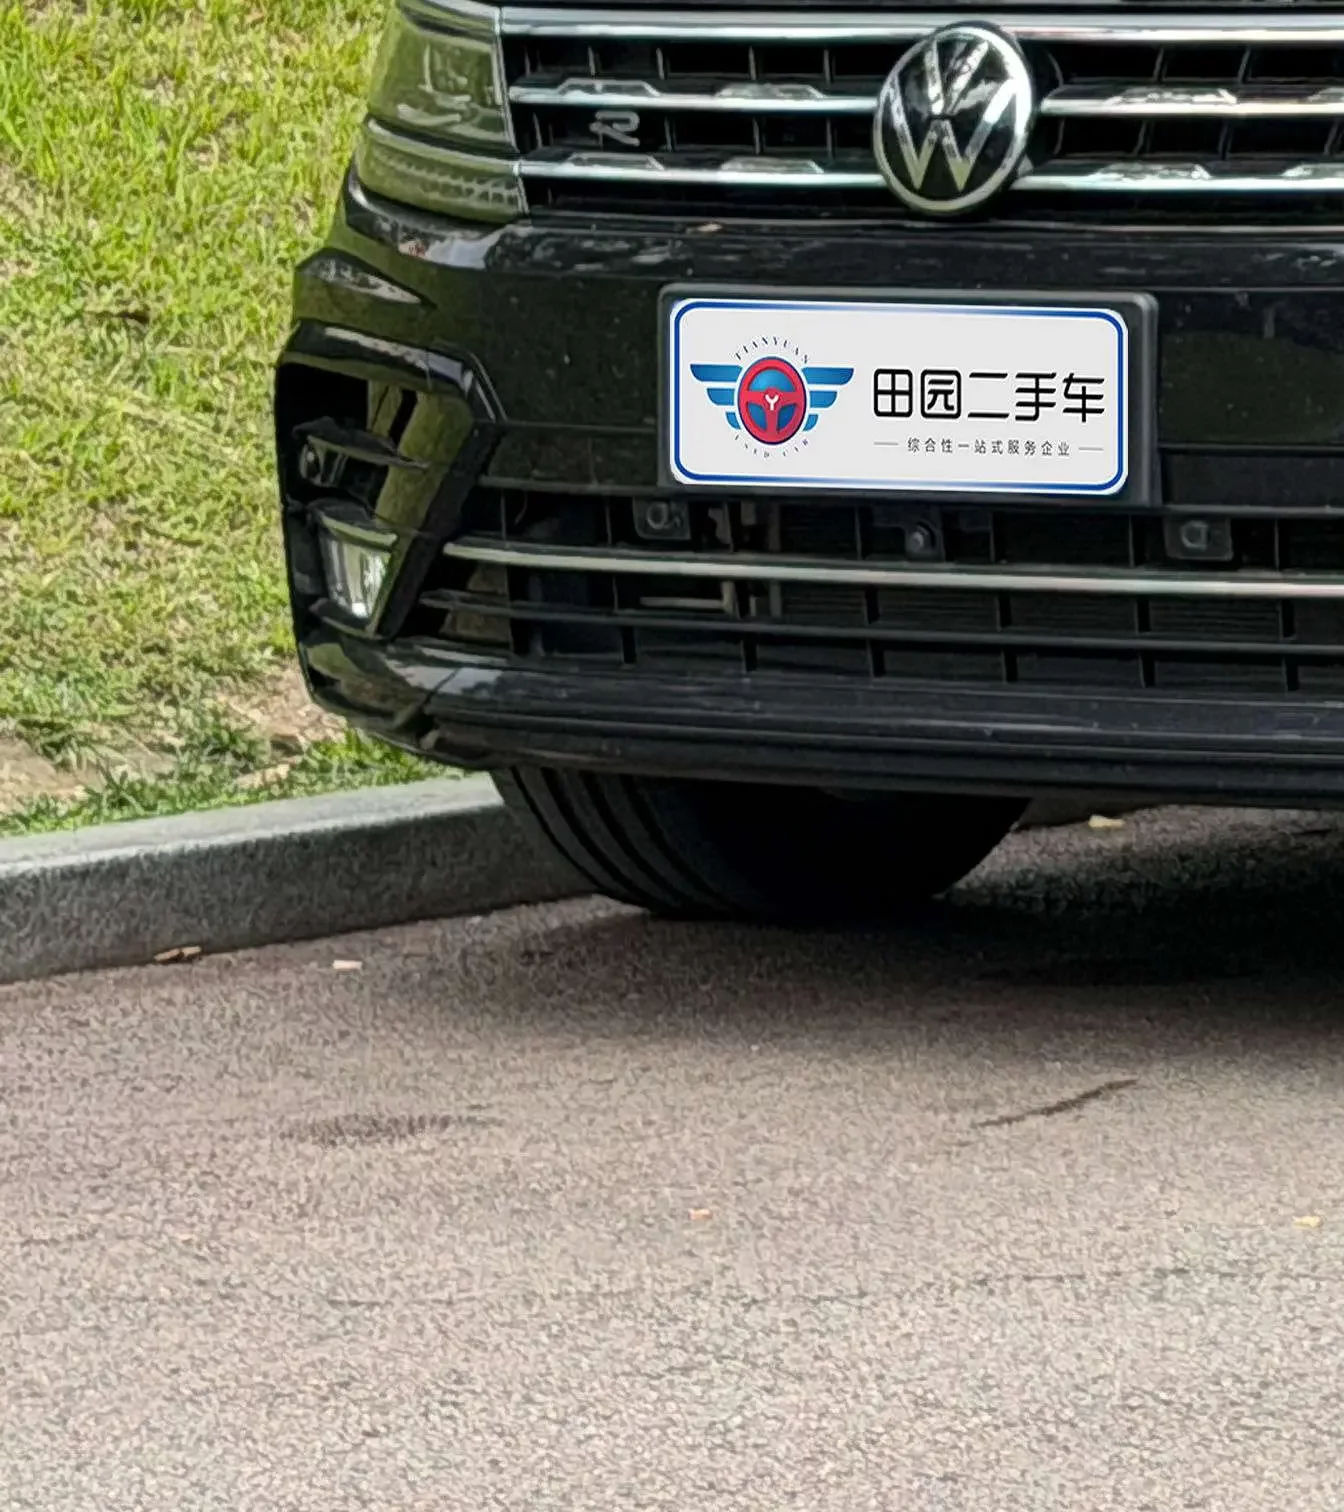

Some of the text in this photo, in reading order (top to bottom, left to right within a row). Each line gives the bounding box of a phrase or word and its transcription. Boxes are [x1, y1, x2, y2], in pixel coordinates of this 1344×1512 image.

[873, 368, 1105, 423] 田园二手车
[907, 437, 1070, 457] 综合性一站式服务企业
